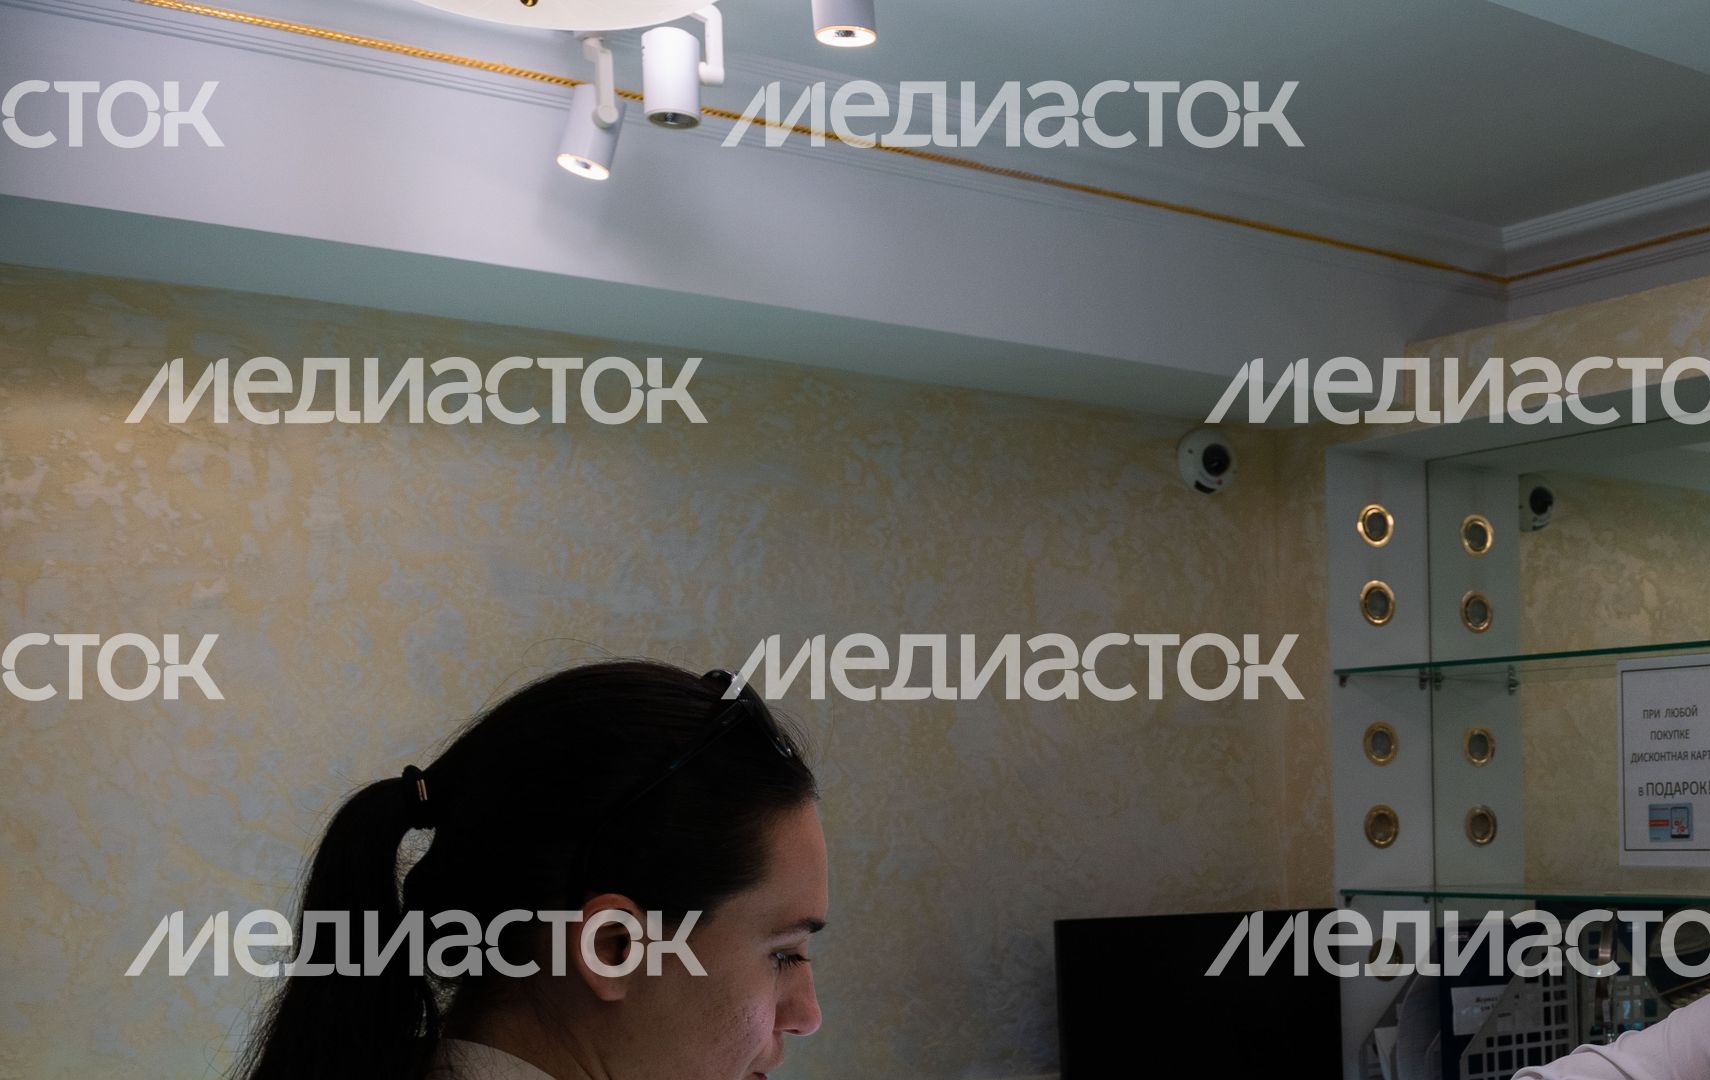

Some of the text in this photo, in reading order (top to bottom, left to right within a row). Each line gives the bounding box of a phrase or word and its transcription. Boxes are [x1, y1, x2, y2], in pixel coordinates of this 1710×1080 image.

[1643, 704, 1698, 719] ПРИ ЛЮБОЙ
[1650, 728, 1690, 740] ПОКУПКЕ
[1630, 751, 1688, 764] ДИСКОНТНАЯ
